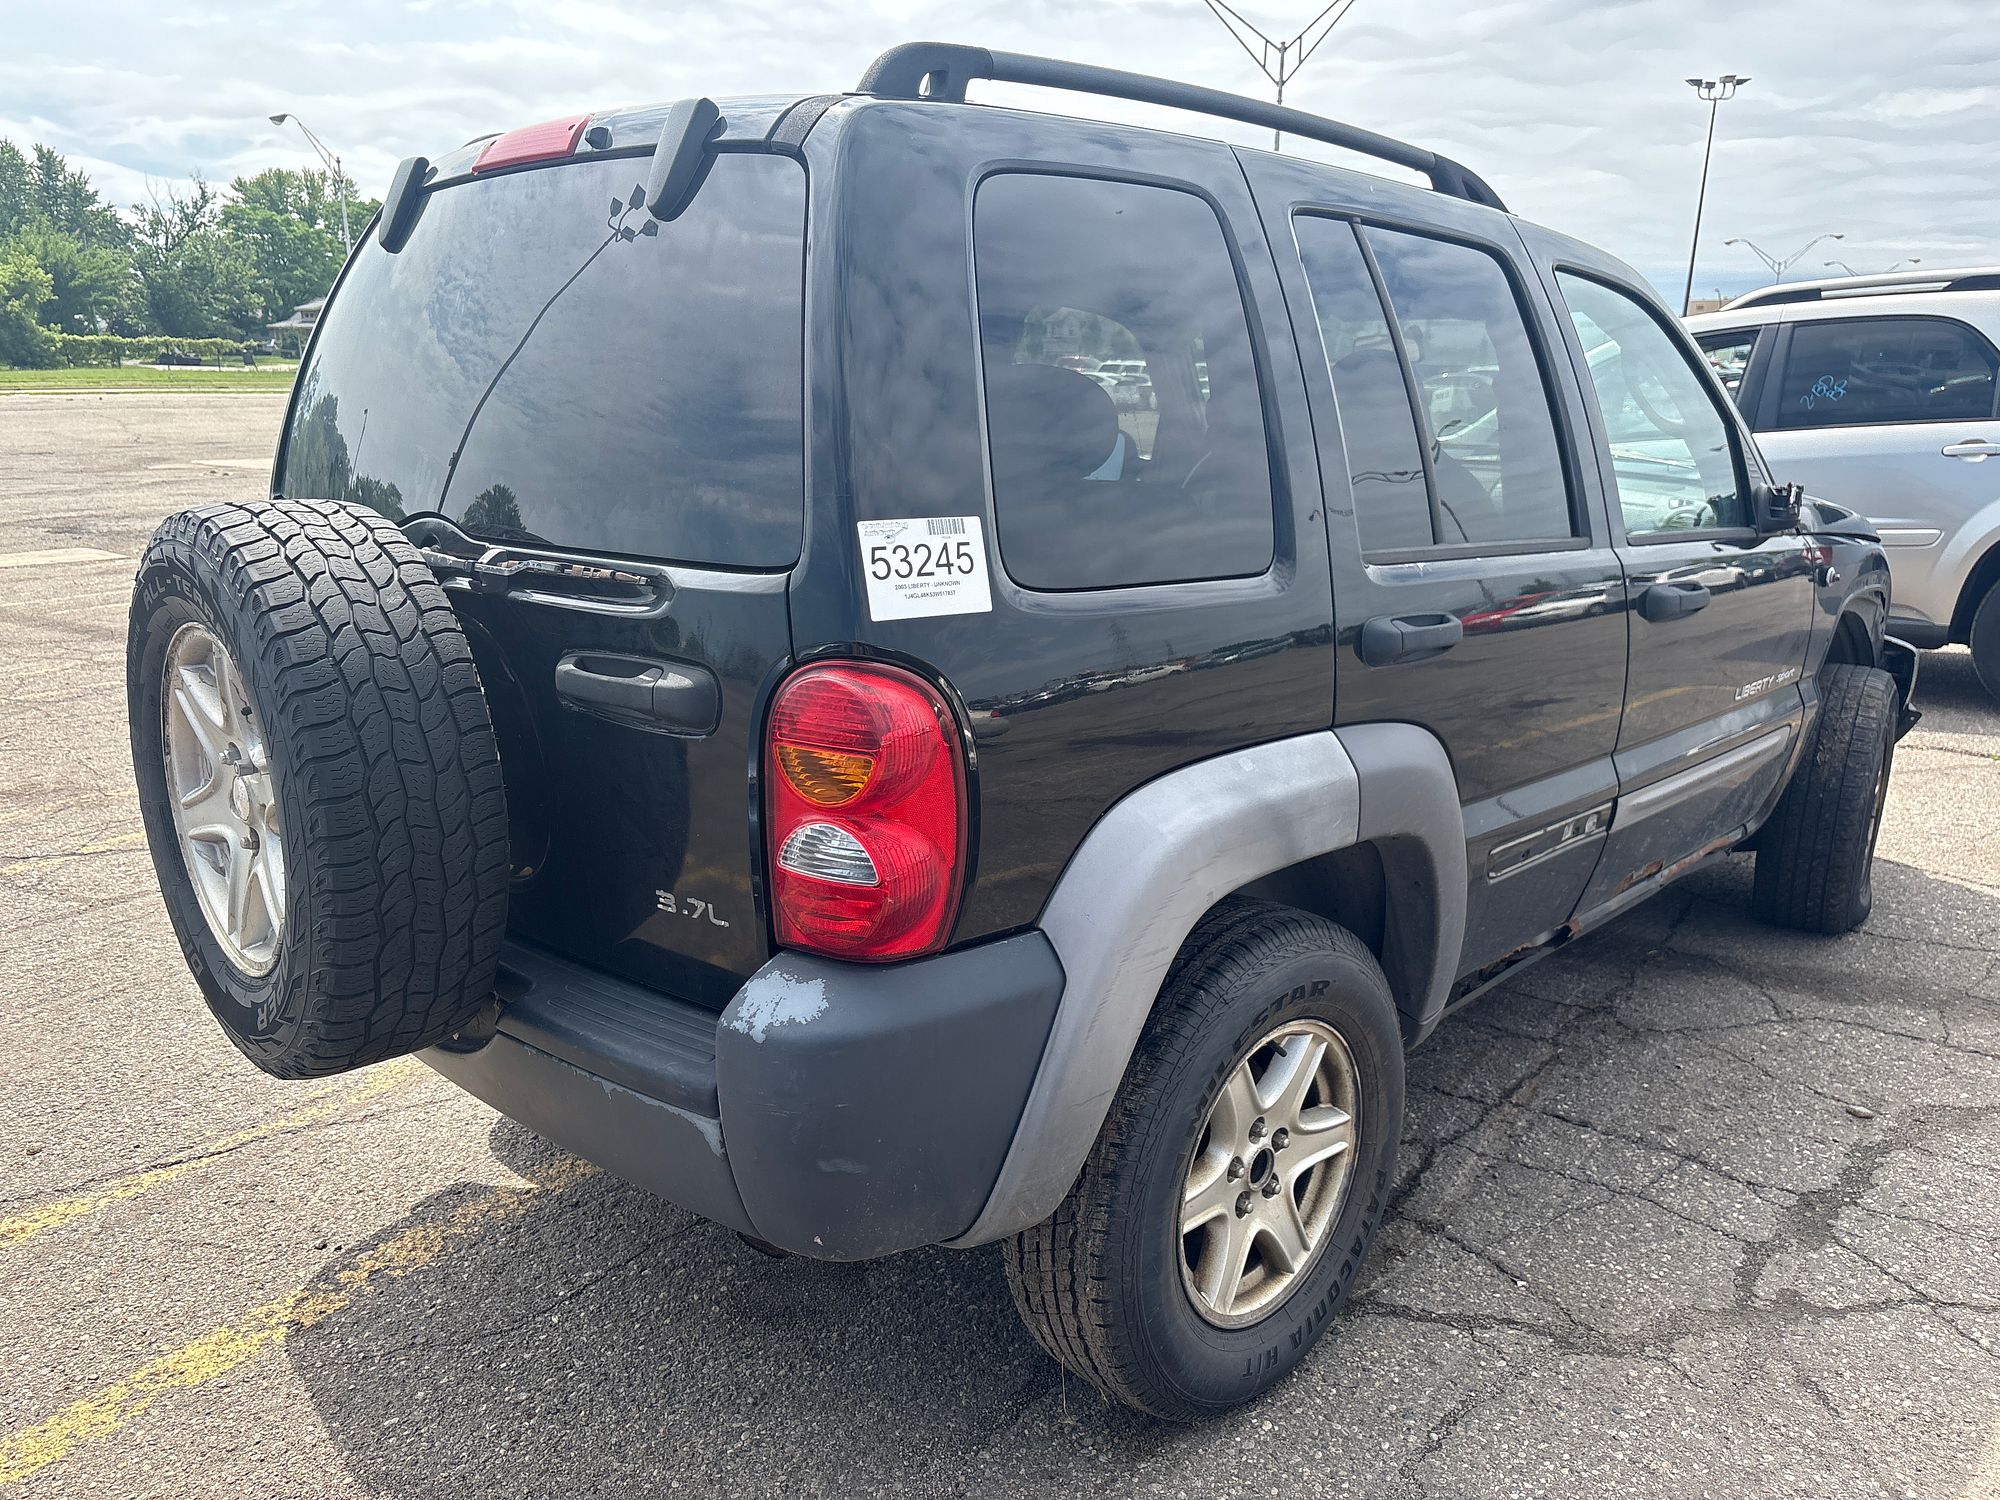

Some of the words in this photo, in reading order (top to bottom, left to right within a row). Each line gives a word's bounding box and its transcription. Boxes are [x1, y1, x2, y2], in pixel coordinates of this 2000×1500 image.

[871, 542, 974, 580] 53245
[907, 582, 931, 590] LIBERTY
[1734, 674, 1775, 701] LIBERTY
[655, 889, 730, 929] 3.7L
